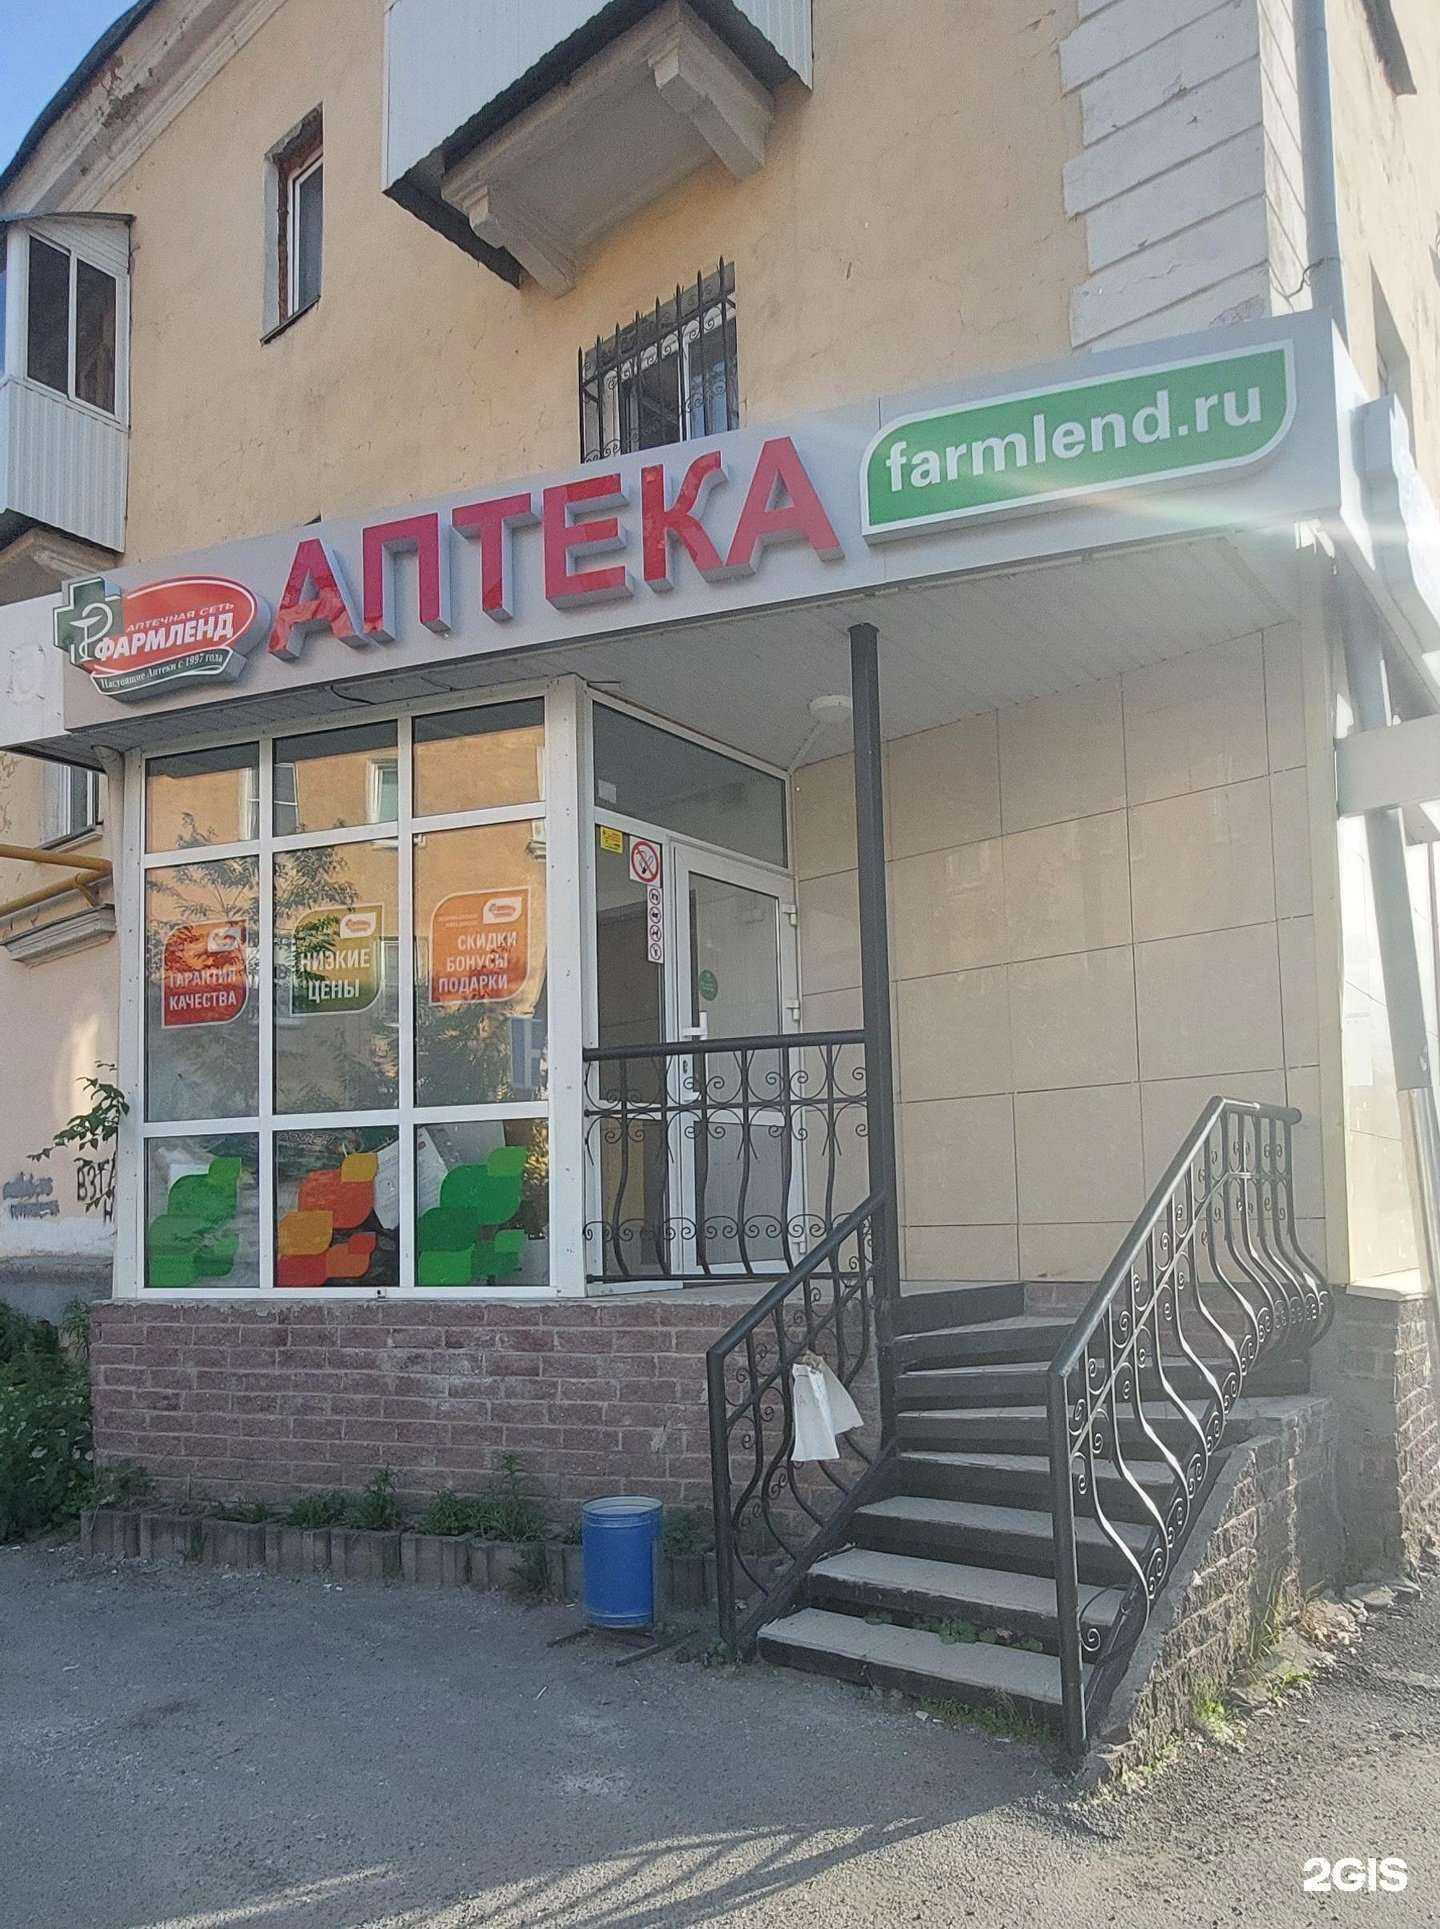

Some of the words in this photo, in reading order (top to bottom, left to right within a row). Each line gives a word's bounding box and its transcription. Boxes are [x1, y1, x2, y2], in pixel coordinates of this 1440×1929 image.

[886, 387, 1262, 492] farmlend.ru
[268, 436, 843, 660] АПТЕКА
[126, 610, 196, 634] АПТЕЧНАЯ
[199, 602, 235, 617] СЕТЬ
[94, 612, 235, 661] ФАРМЛЕНД
[457, 931, 518, 951] СКИДКИ
[300, 948, 371, 972] НИЗКИЕ
[446, 952, 508, 972] БОНУСЫ
[307, 978, 360, 1004] ЦЕНЫ
[438, 973, 508, 994] ПОДАРКИ
[169, 989, 237, 1012] КАЧЕСТВА
